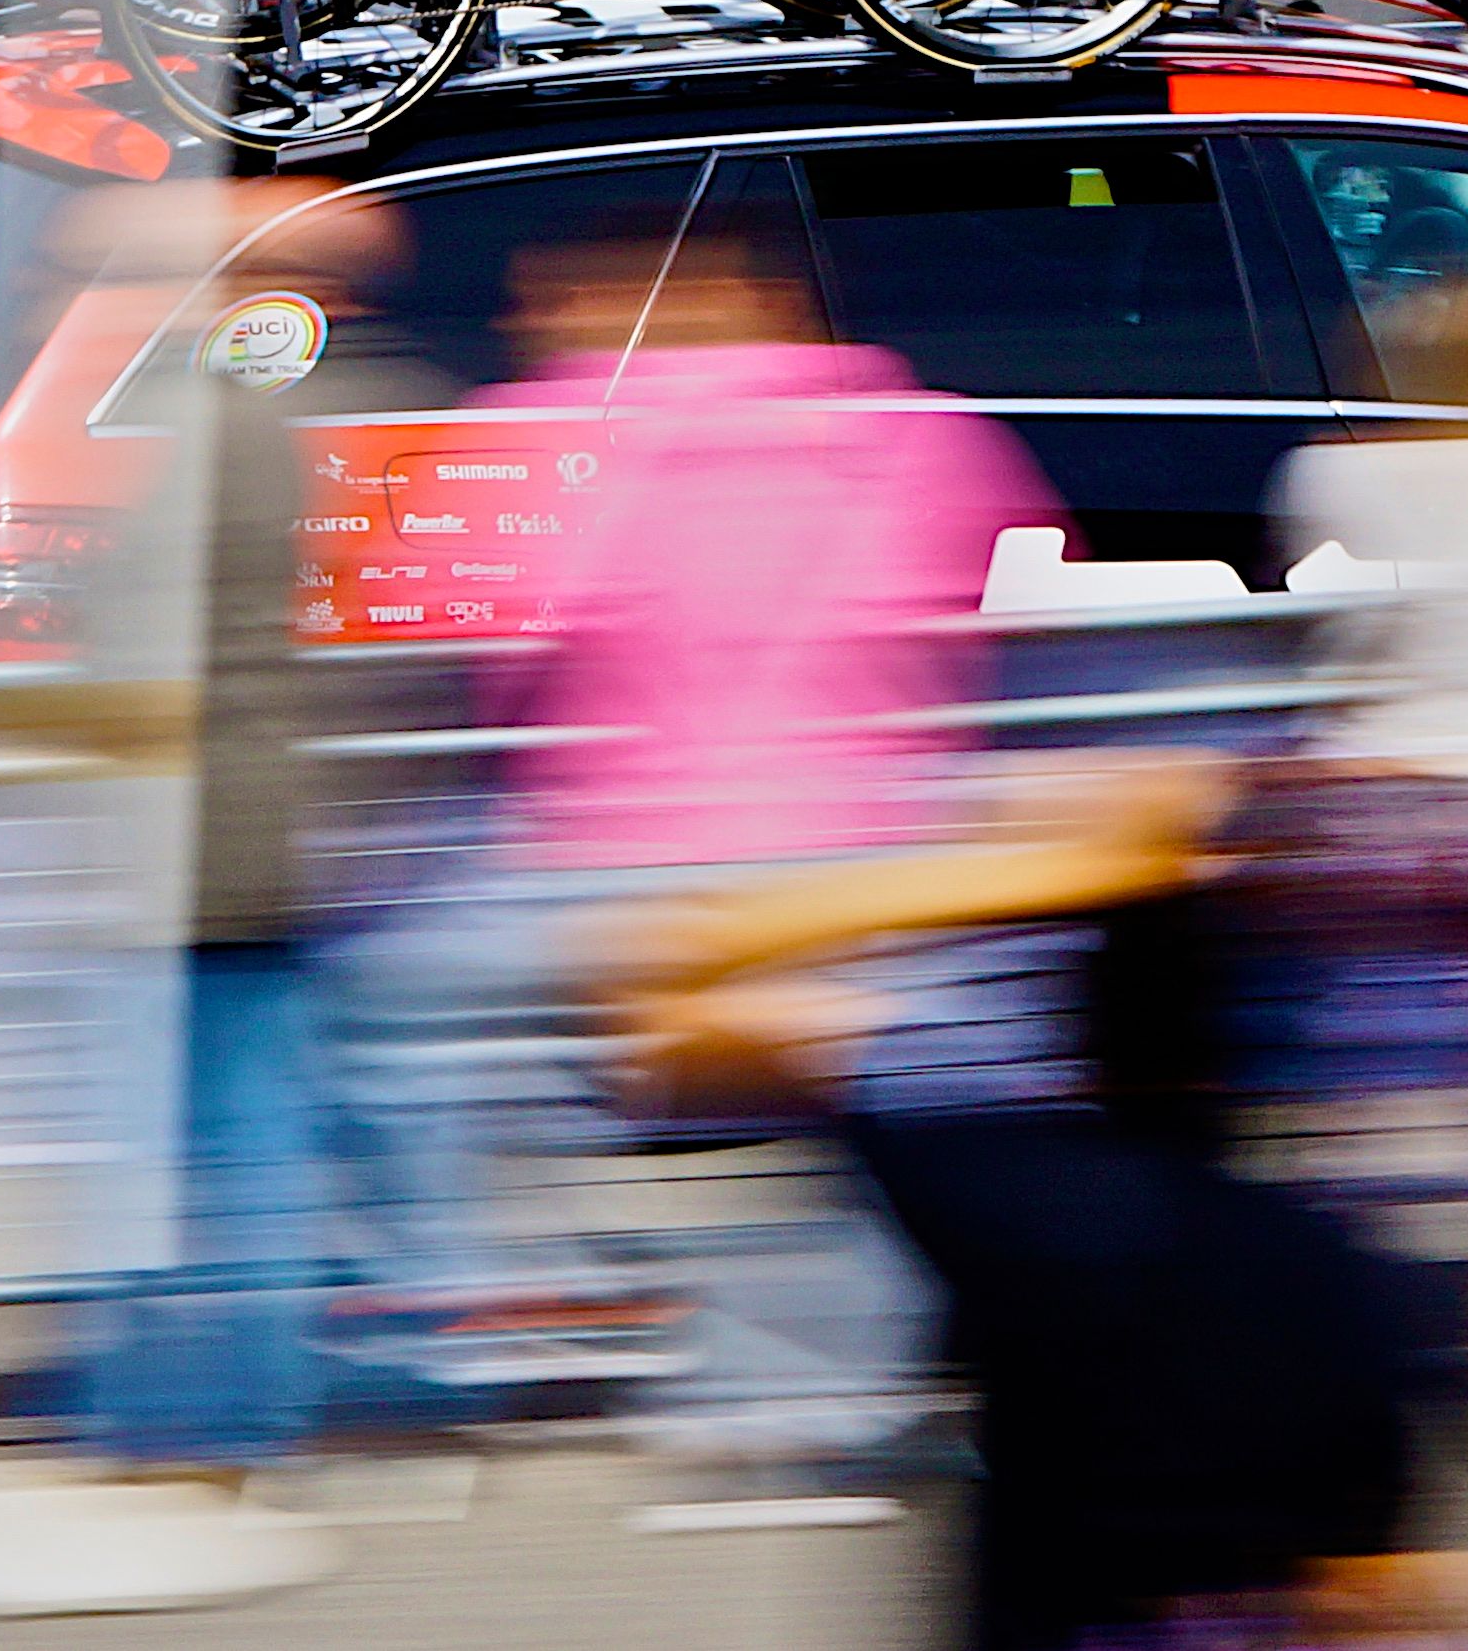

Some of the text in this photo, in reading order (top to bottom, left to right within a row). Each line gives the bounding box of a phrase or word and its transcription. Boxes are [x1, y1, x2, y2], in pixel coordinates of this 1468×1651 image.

[248, 364, 271, 375] TIME
[436, 464, 529, 481] SHIMANO
[304, 516, 370, 532] GIRO
[367, 605, 424, 623] THULE
